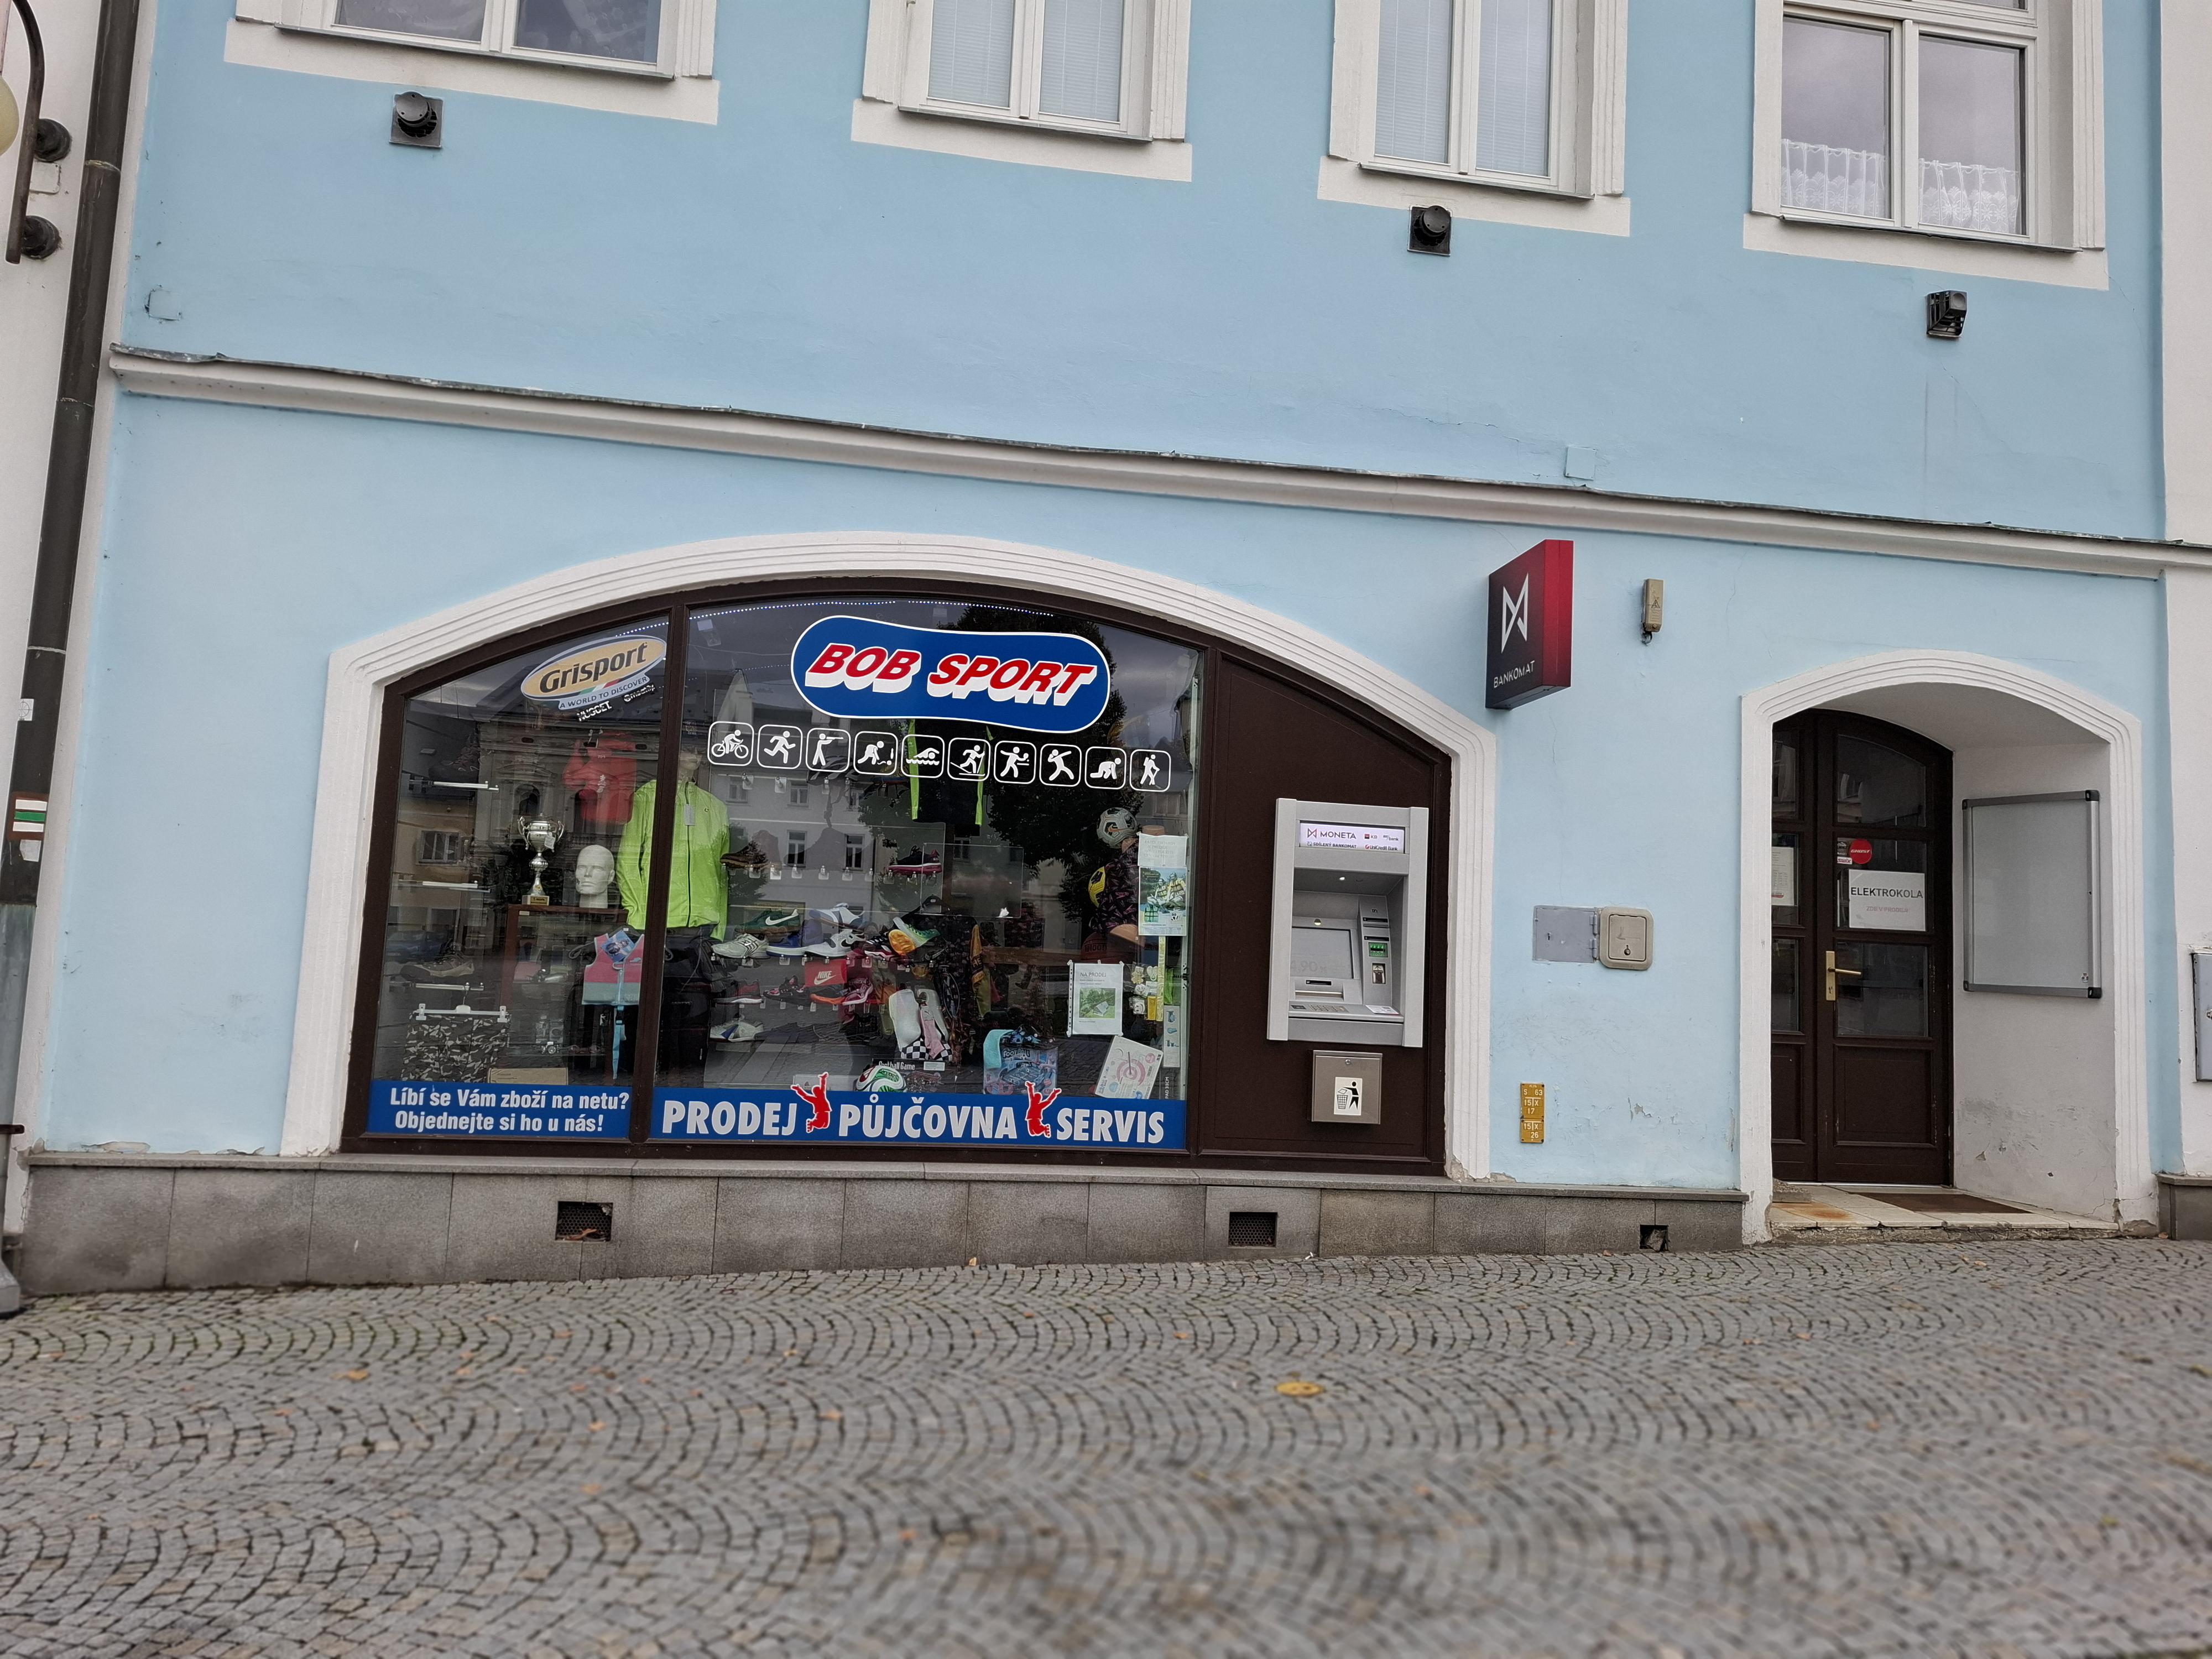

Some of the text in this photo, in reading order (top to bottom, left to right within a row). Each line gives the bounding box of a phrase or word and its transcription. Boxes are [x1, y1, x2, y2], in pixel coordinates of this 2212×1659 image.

[539, 642, 648, 693] Grisport
[806, 643, 1097, 707] BOB SPORT
[1494, 660, 1535, 688] BANKOMAT
[568, 695, 597, 708] WORLD
[598, 691, 609, 700] TO
[611, 676, 648, 696] DISCOVER
[1320, 831, 1357, 840] MONETA
[1851, 887, 1923, 899] ELEKTROKOLA
[817, 971, 832, 979] NIKE
[900, 1061, 915, 1071] Game
[390, 1087, 630, 1110] Líbí se Vám zboží na netu?
[395, 1110, 604, 1134] Objednejte si ho u nás!
[662, 1094, 1165, 1144] PRODEJ PŮJČOVNA SERVIS
